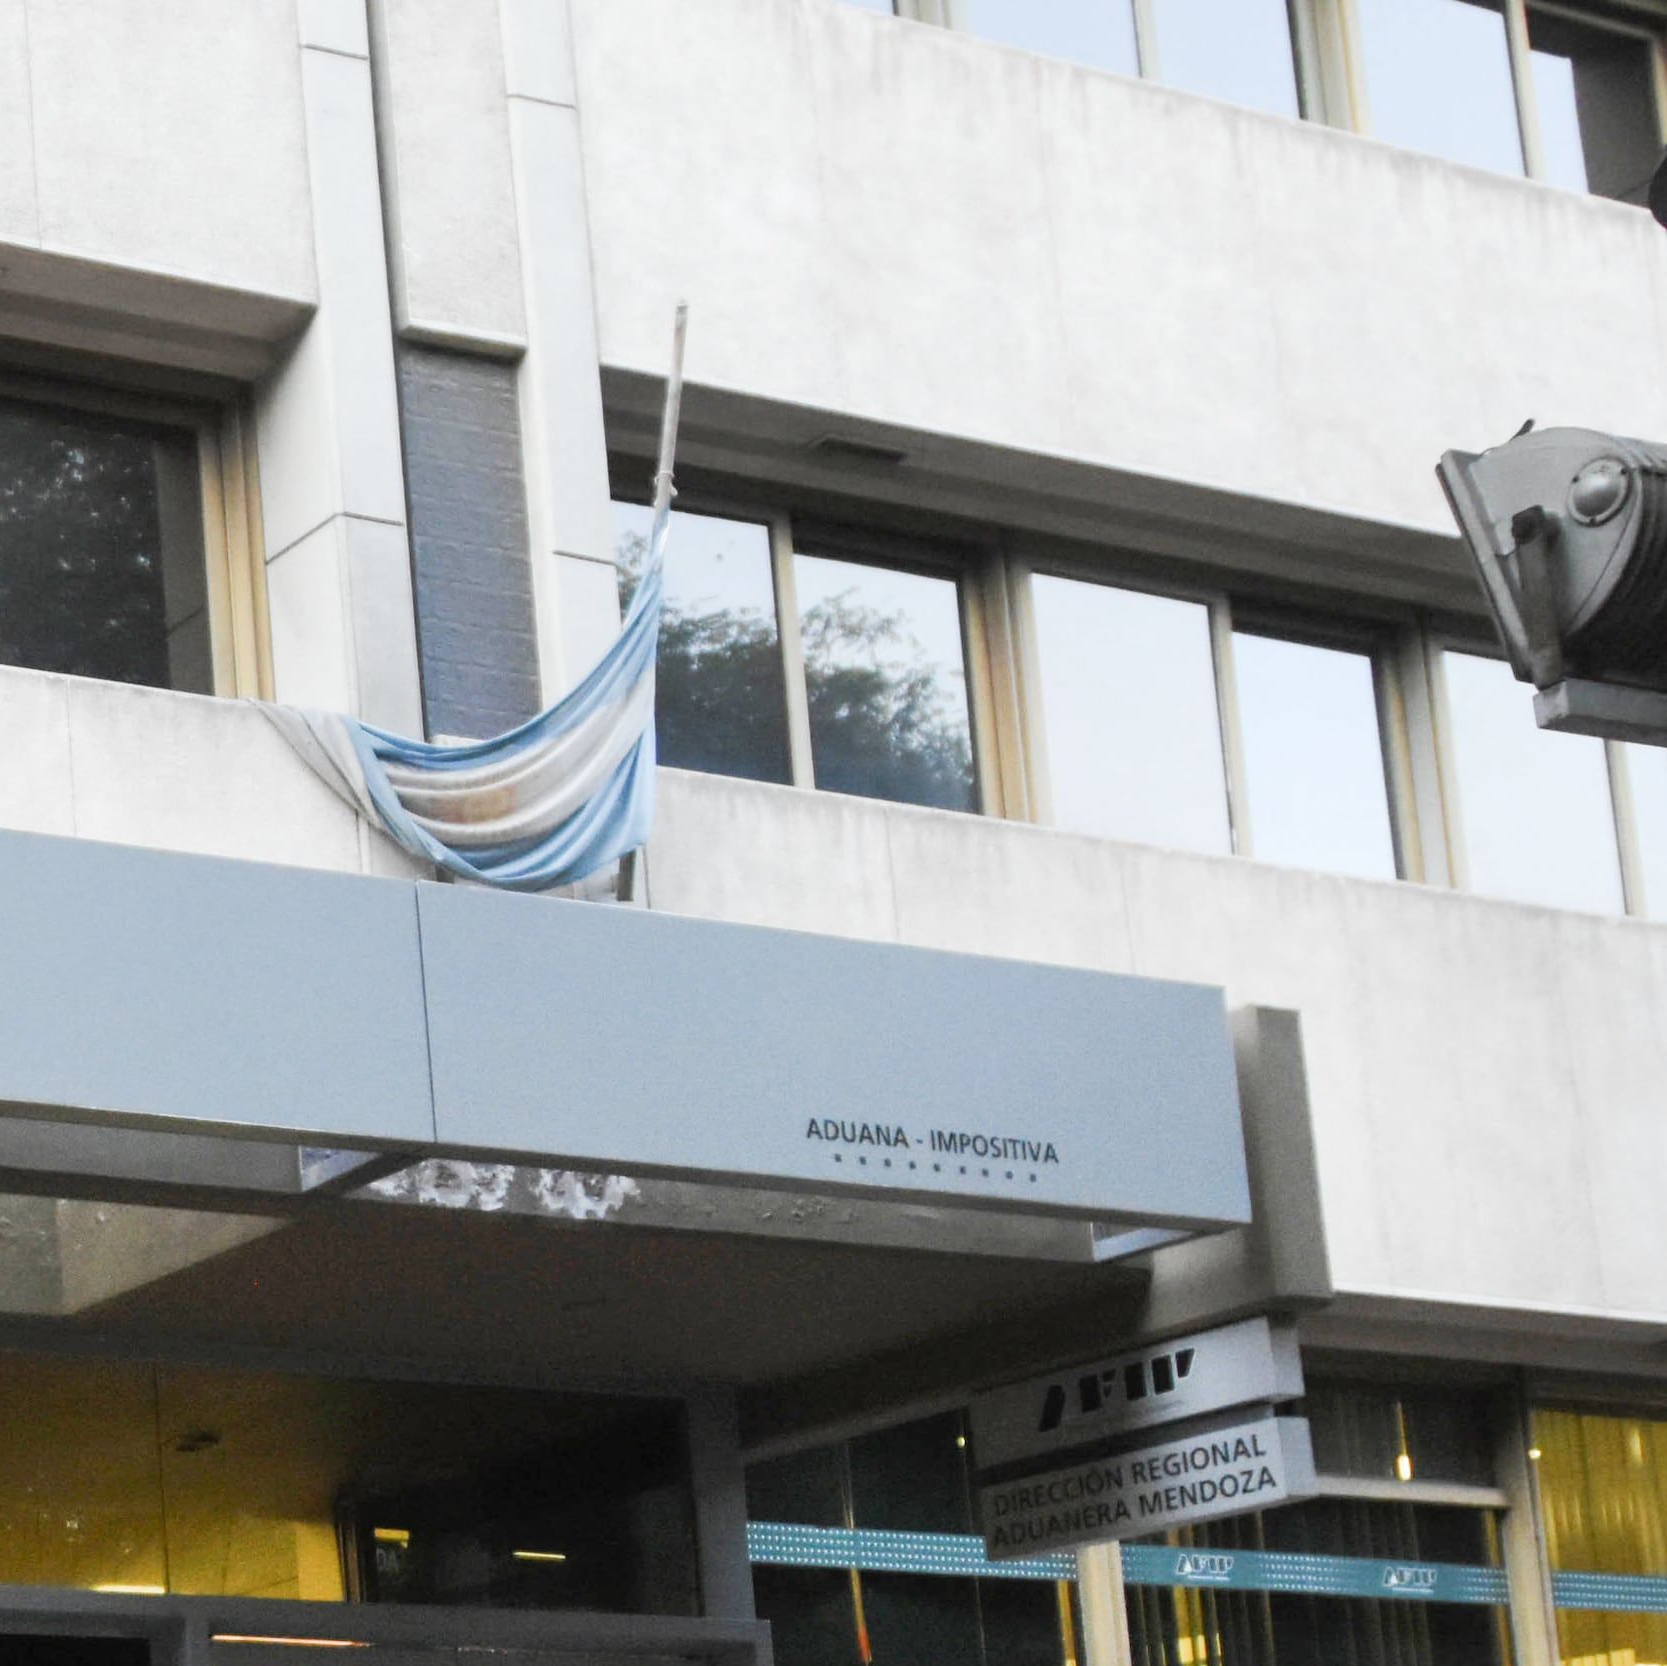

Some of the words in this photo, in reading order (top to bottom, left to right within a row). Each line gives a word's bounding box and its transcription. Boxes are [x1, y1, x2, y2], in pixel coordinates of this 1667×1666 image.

[806, 1118, 910, 1149] ADUANA
[930, 1130, 1059, 1163] IMPOSITIVA
[1038, 1347, 1195, 1432] AFIP
[1131, 1434, 1267, 1485] REGIONAL
[994, 1502, 1131, 1547] ADUANERA
[1138, 1466, 1277, 1518] MENDOZA
